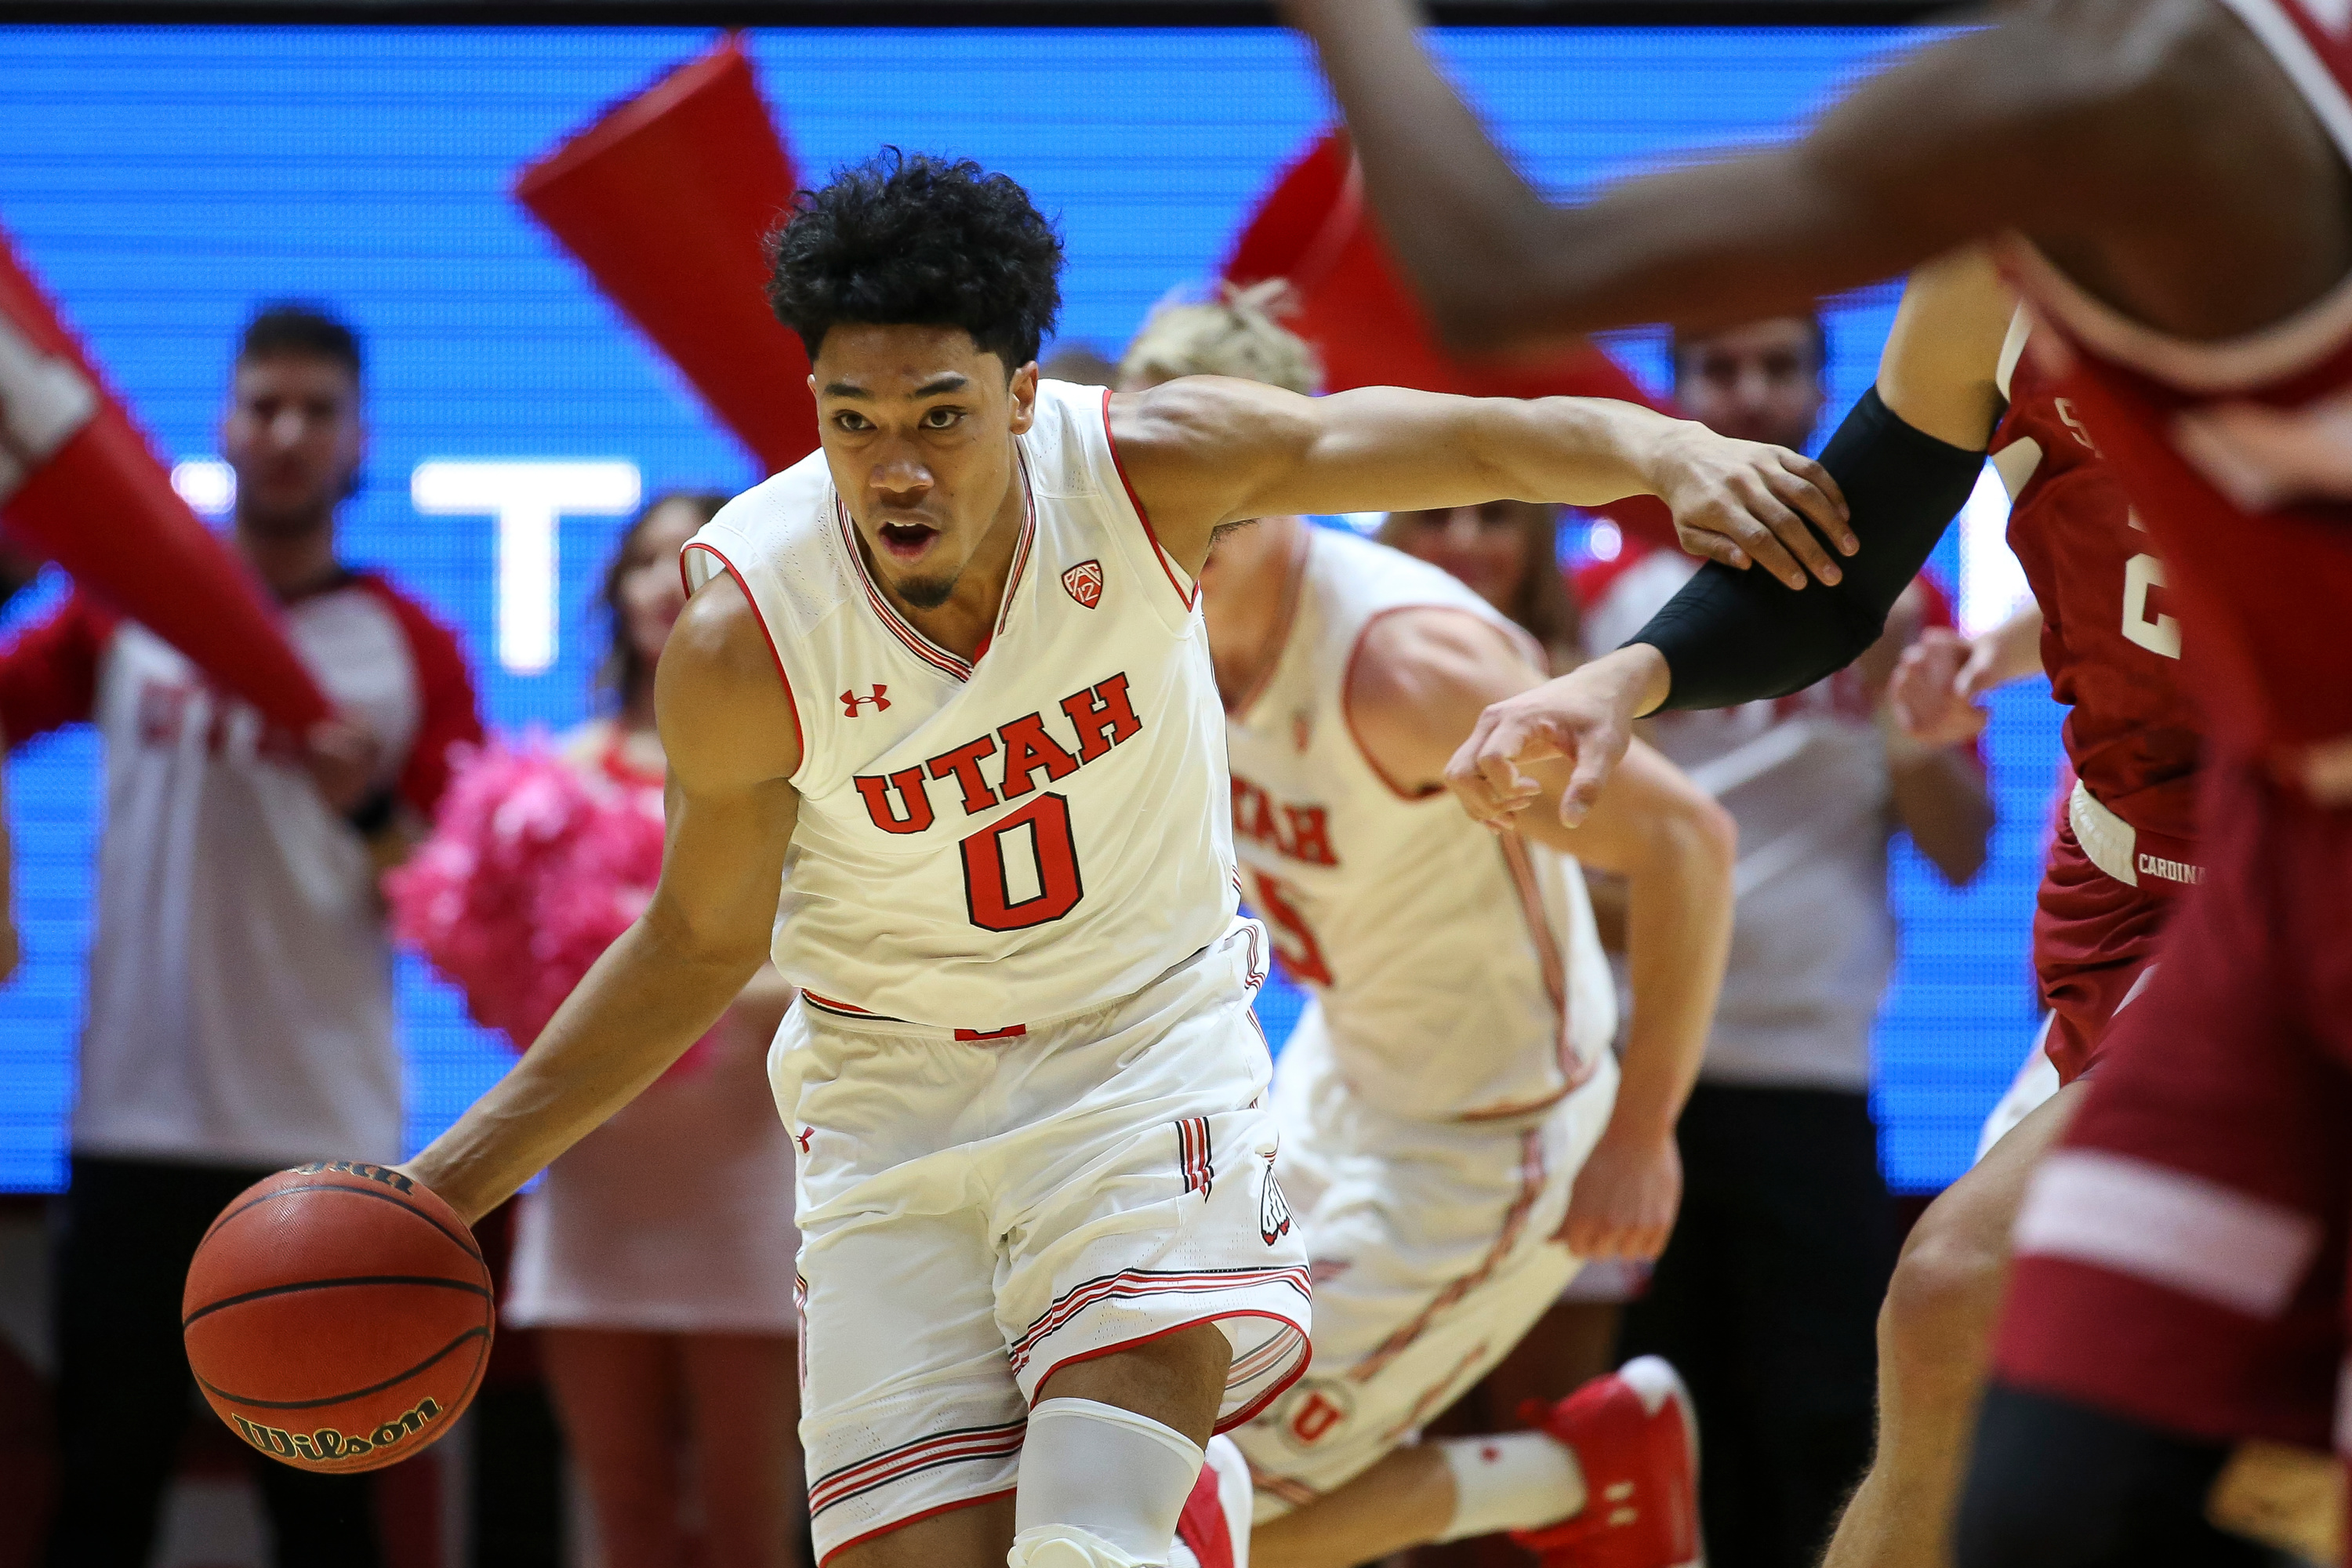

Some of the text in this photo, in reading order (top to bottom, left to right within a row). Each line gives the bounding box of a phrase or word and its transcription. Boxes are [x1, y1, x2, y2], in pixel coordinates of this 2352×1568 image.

[1064, 564, 1102, 597] PAC
[1076, 582, 1099, 603] 12
[854, 672, 1142, 834] UTAH
[1231, 773, 1339, 867] AH
[960, 791, 1083, 932] 0
[231, 1396, 443, 1461] Wilson
